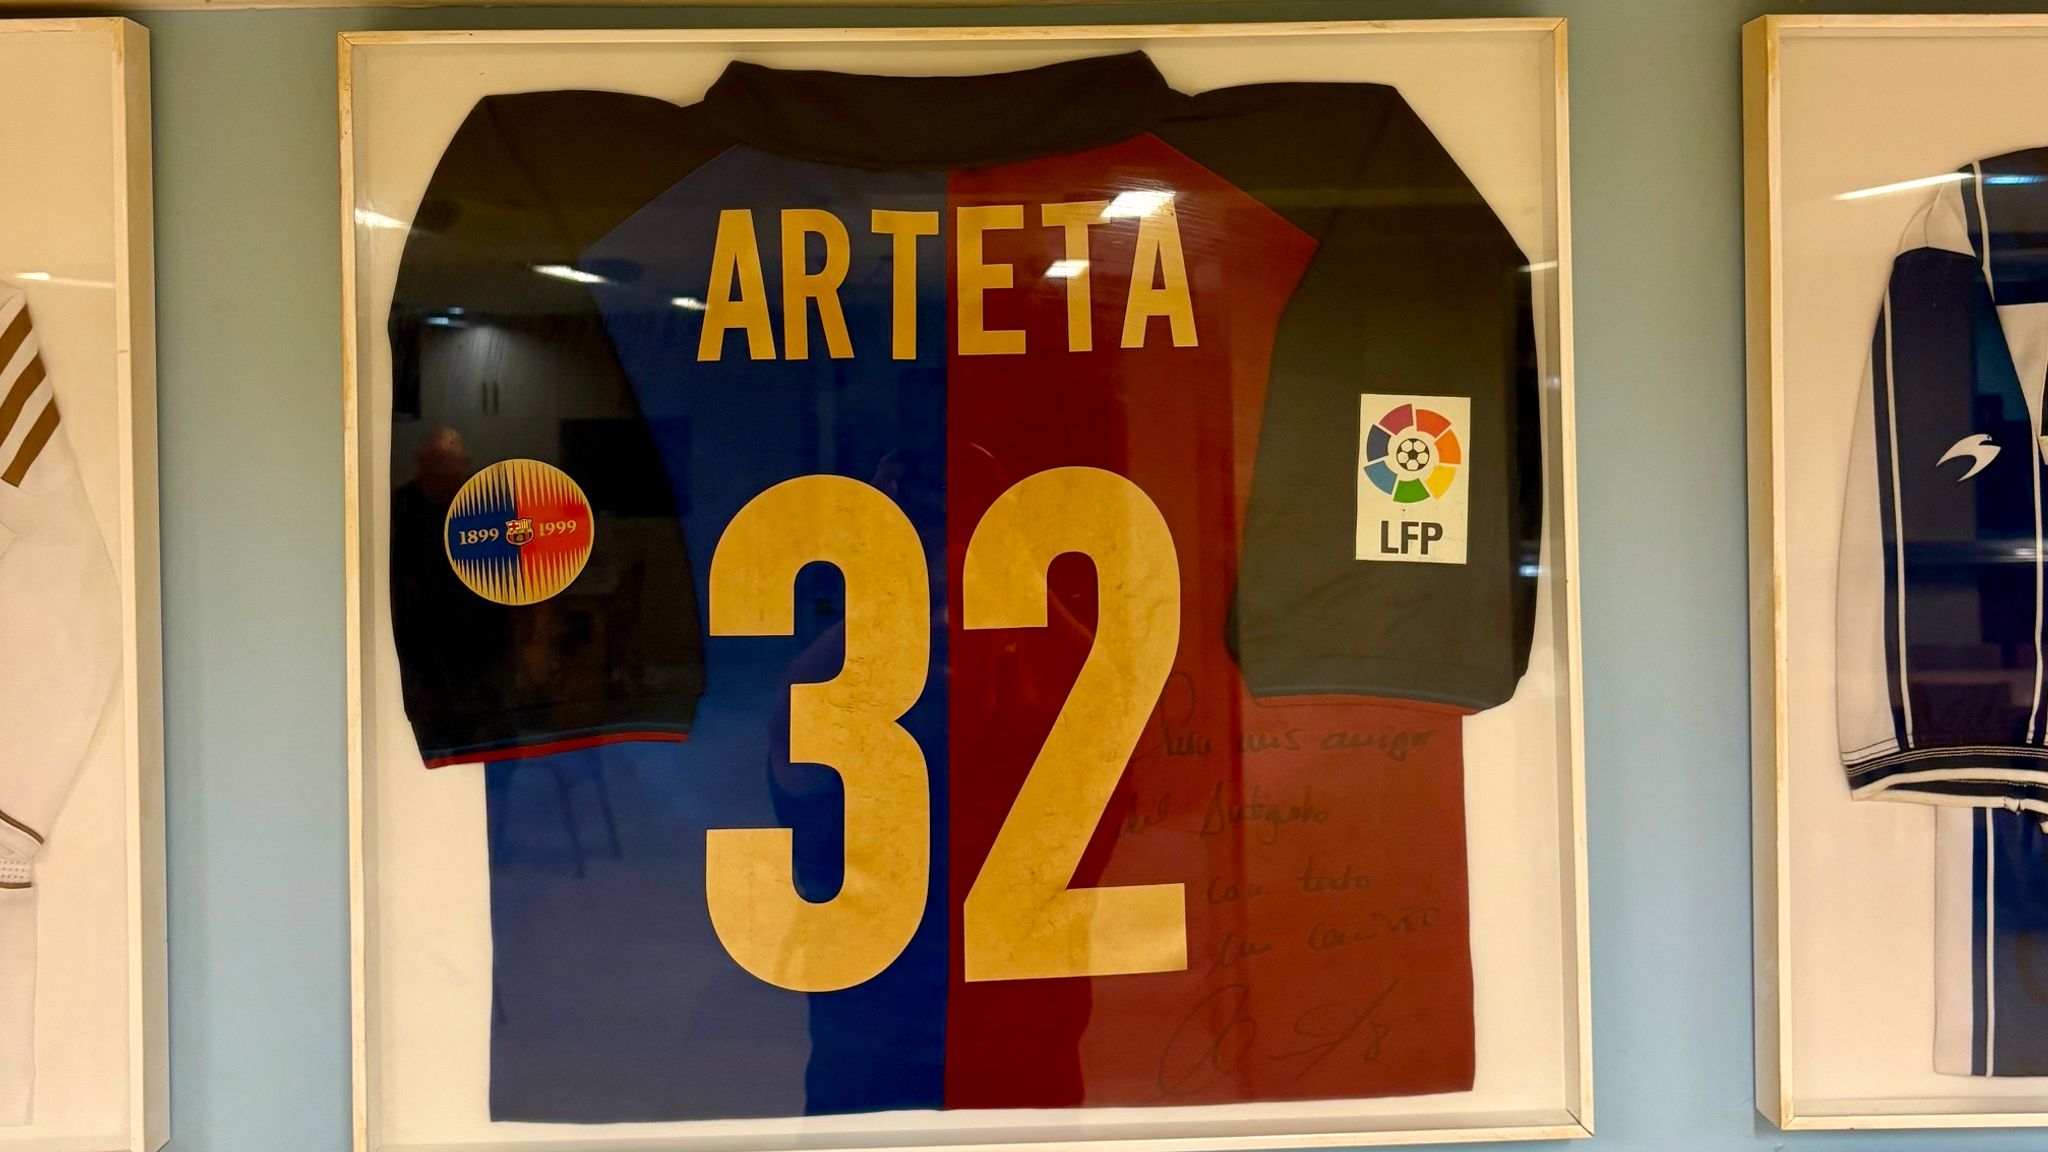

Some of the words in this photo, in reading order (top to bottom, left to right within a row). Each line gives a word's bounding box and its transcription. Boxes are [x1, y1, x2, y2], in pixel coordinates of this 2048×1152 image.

[697, 200, 1199, 362] ARTETA
[459, 528, 500, 545] 1899
[538, 520, 577, 537] 1999
[1380, 520, 1443, 555] LFP
[706, 466, 1188, 992] 32
